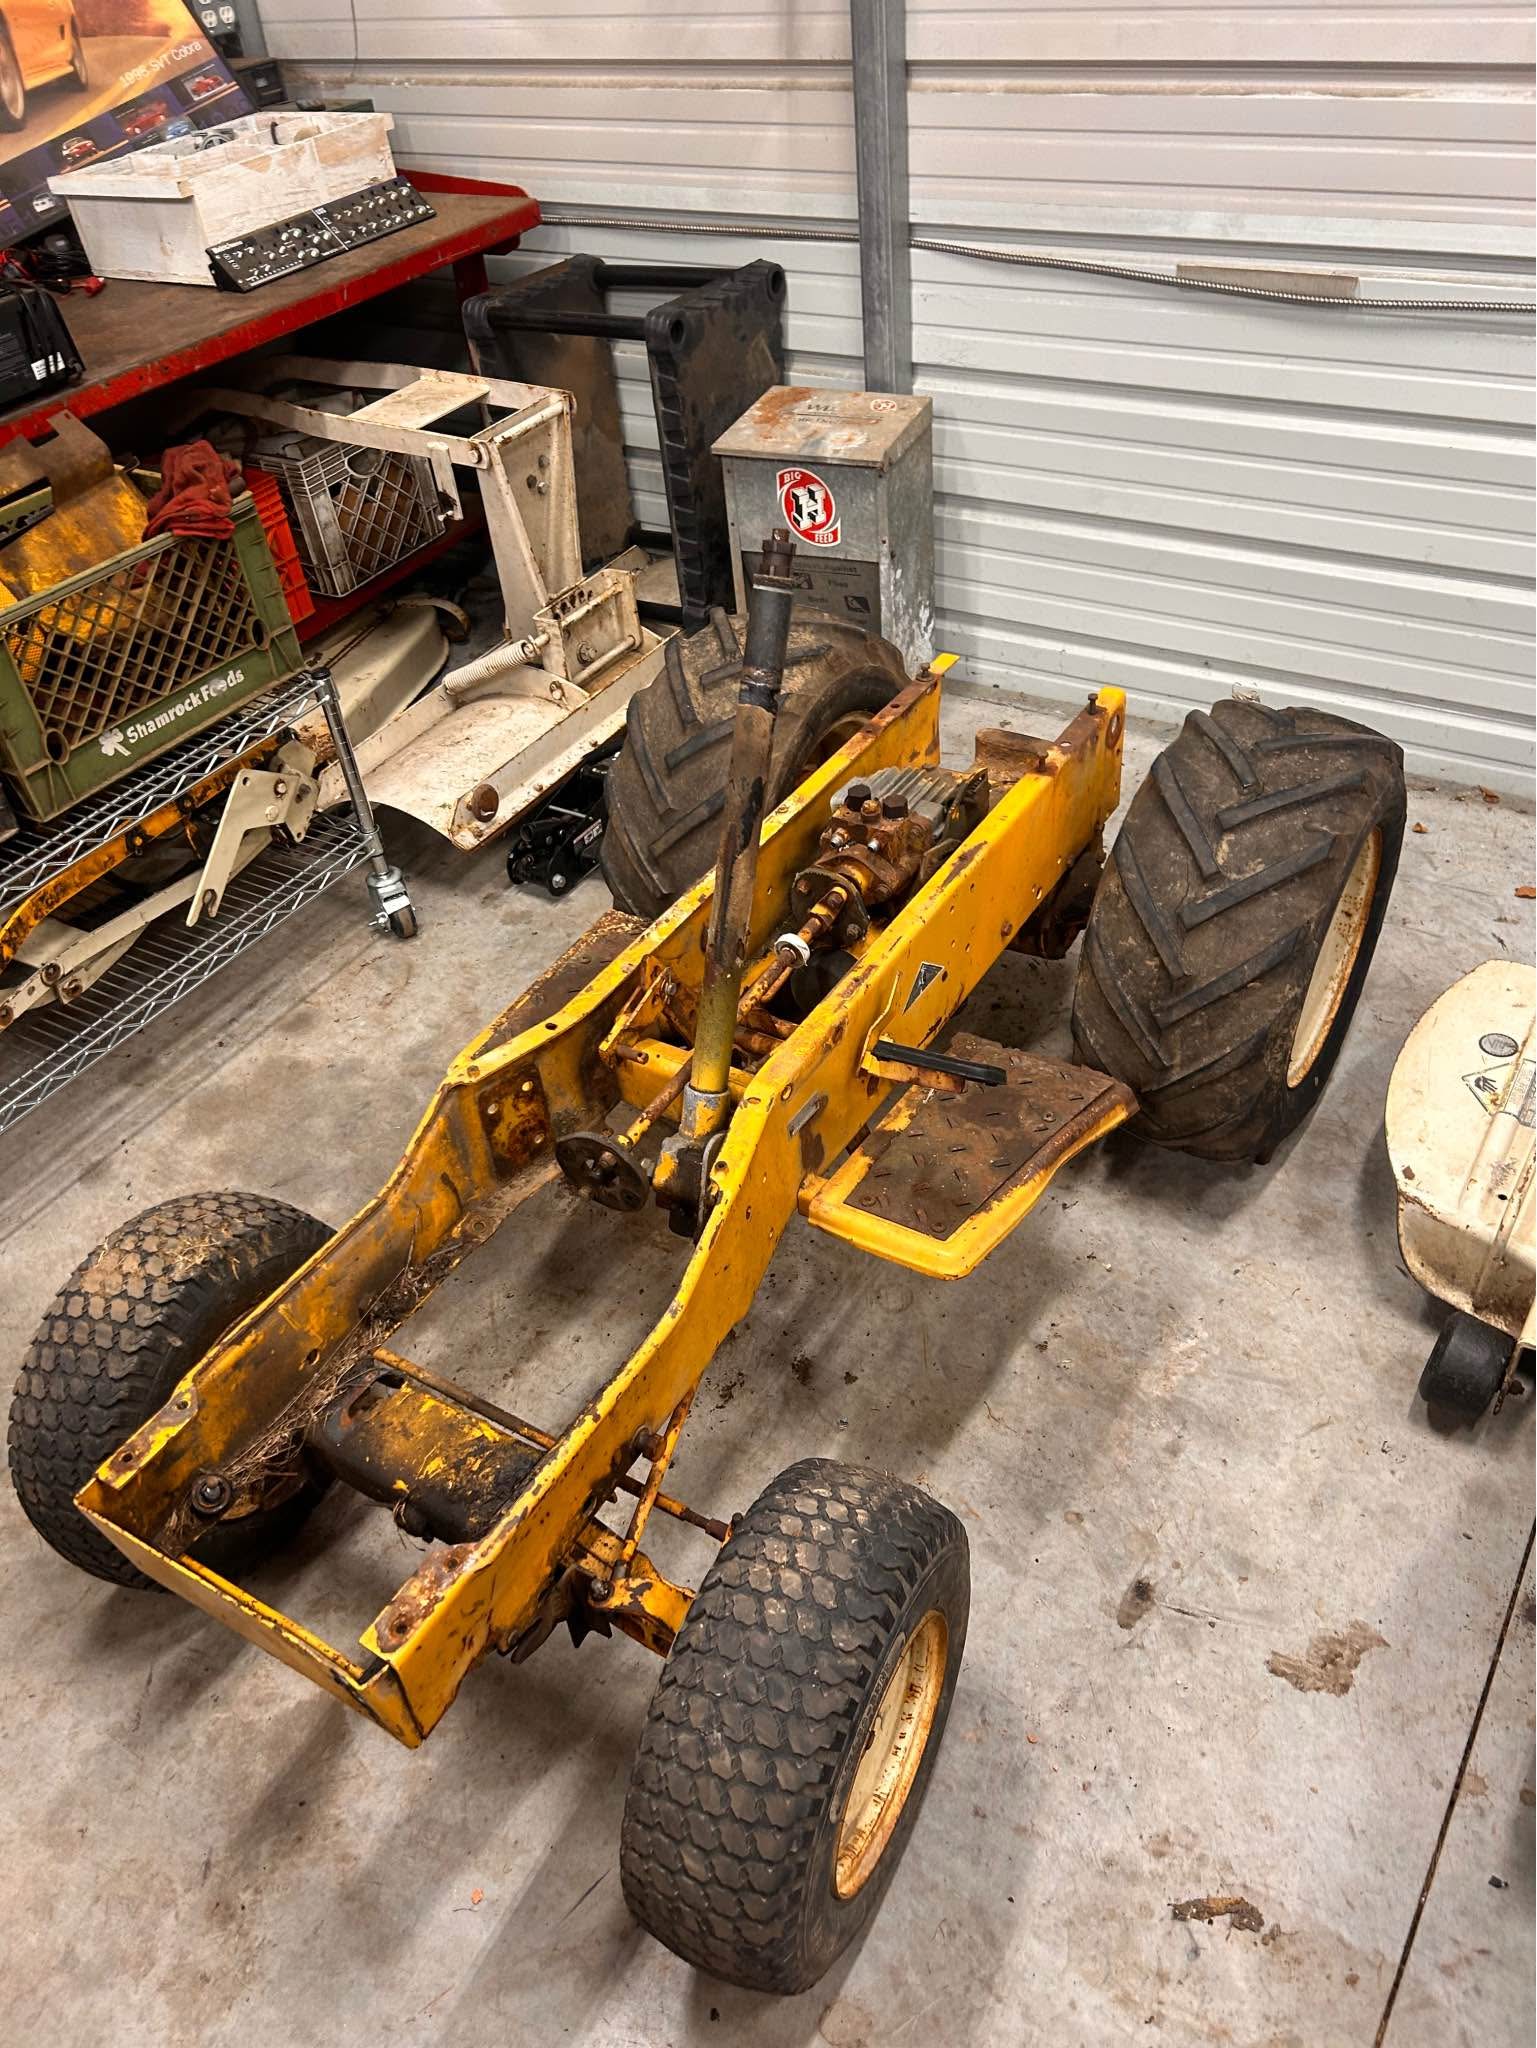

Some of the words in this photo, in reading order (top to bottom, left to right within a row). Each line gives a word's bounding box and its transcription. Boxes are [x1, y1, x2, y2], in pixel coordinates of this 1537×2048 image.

[149, 54, 172, 72] SVT
[171, 41, 202, 61] Cobra
[783, 472, 802, 484] BIG
[815, 533, 834, 543] FEED
[126, 692, 202, 743] Shamrock
